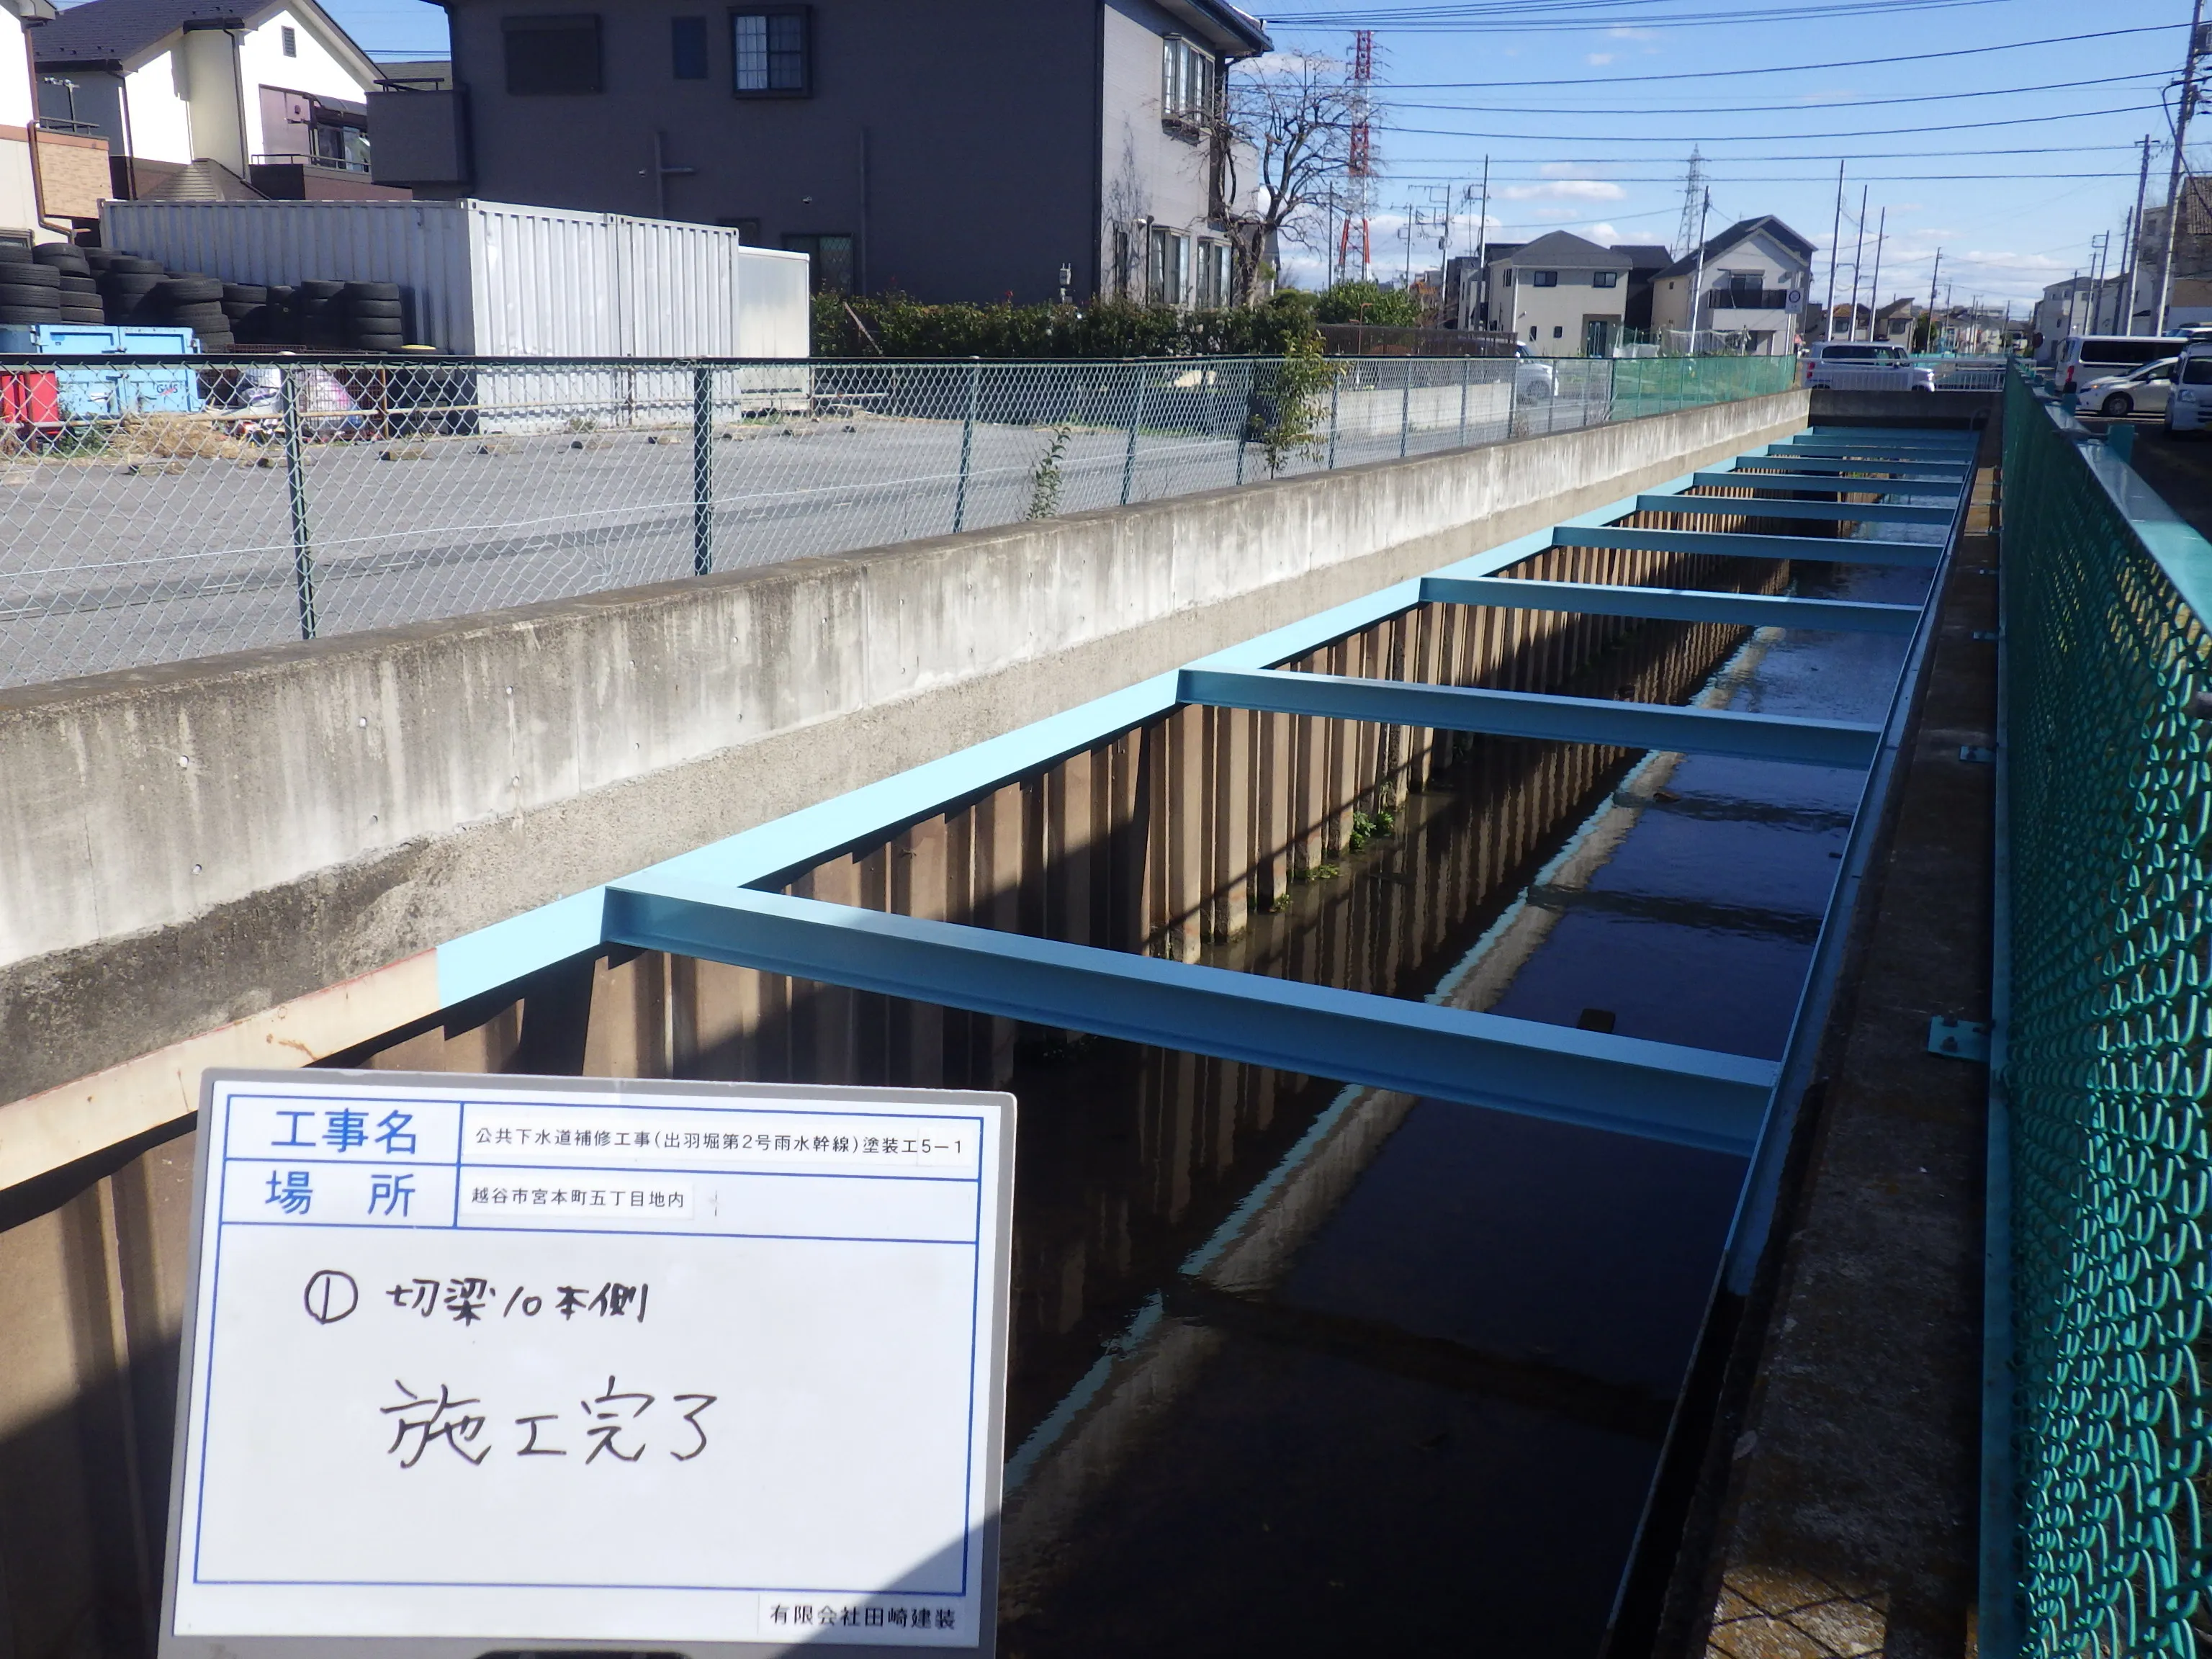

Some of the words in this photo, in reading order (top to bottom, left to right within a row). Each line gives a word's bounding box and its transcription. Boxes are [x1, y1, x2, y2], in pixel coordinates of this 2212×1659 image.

[271, 1107, 418, 1154] 工事名
[472, 1186, 684, 1209] 越谷市宮本町五丁目地内
[379, 1375, 717, 1467] 施工完了
[769, 1604, 956, 1631] 有限会社田崎建装
